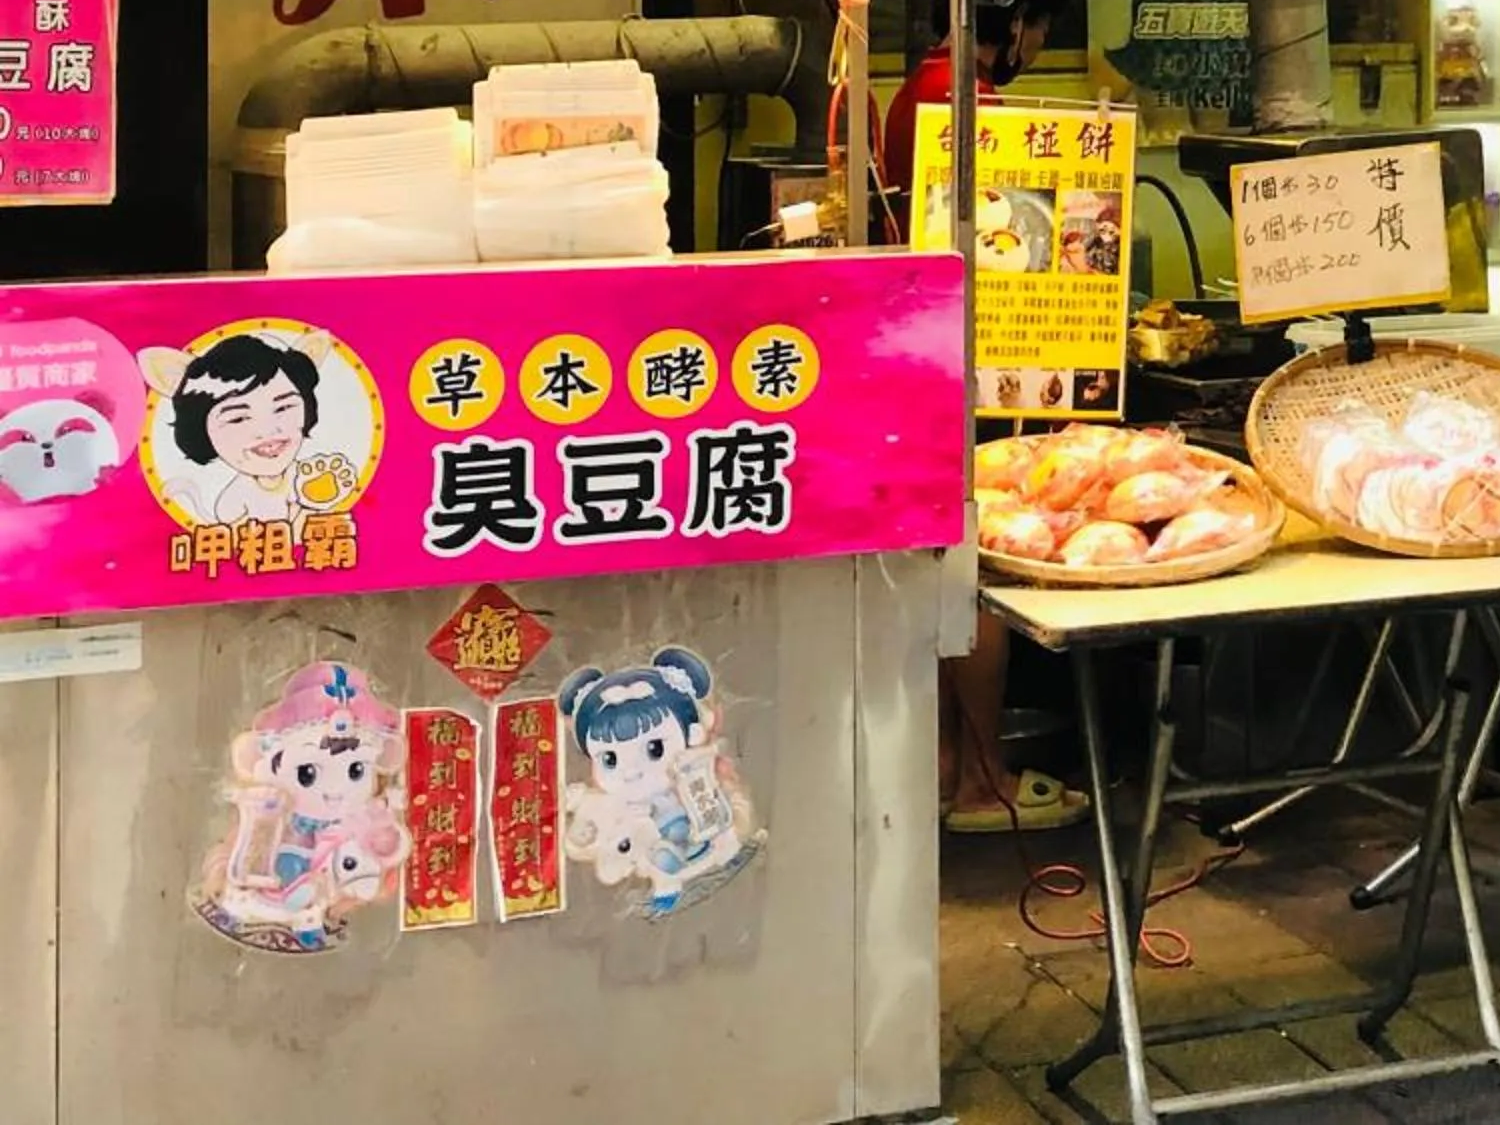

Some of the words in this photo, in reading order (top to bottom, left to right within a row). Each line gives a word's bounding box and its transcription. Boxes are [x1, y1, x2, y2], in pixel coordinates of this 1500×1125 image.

[0, 40, 94, 93] 豆腐
[1365, 157, 1412, 252] 特價
[424, 340, 803, 418] 草本酵素
[423, 423, 795, 557] 臭豆腐
[168, 515, 359, 579] 呷粗霸
